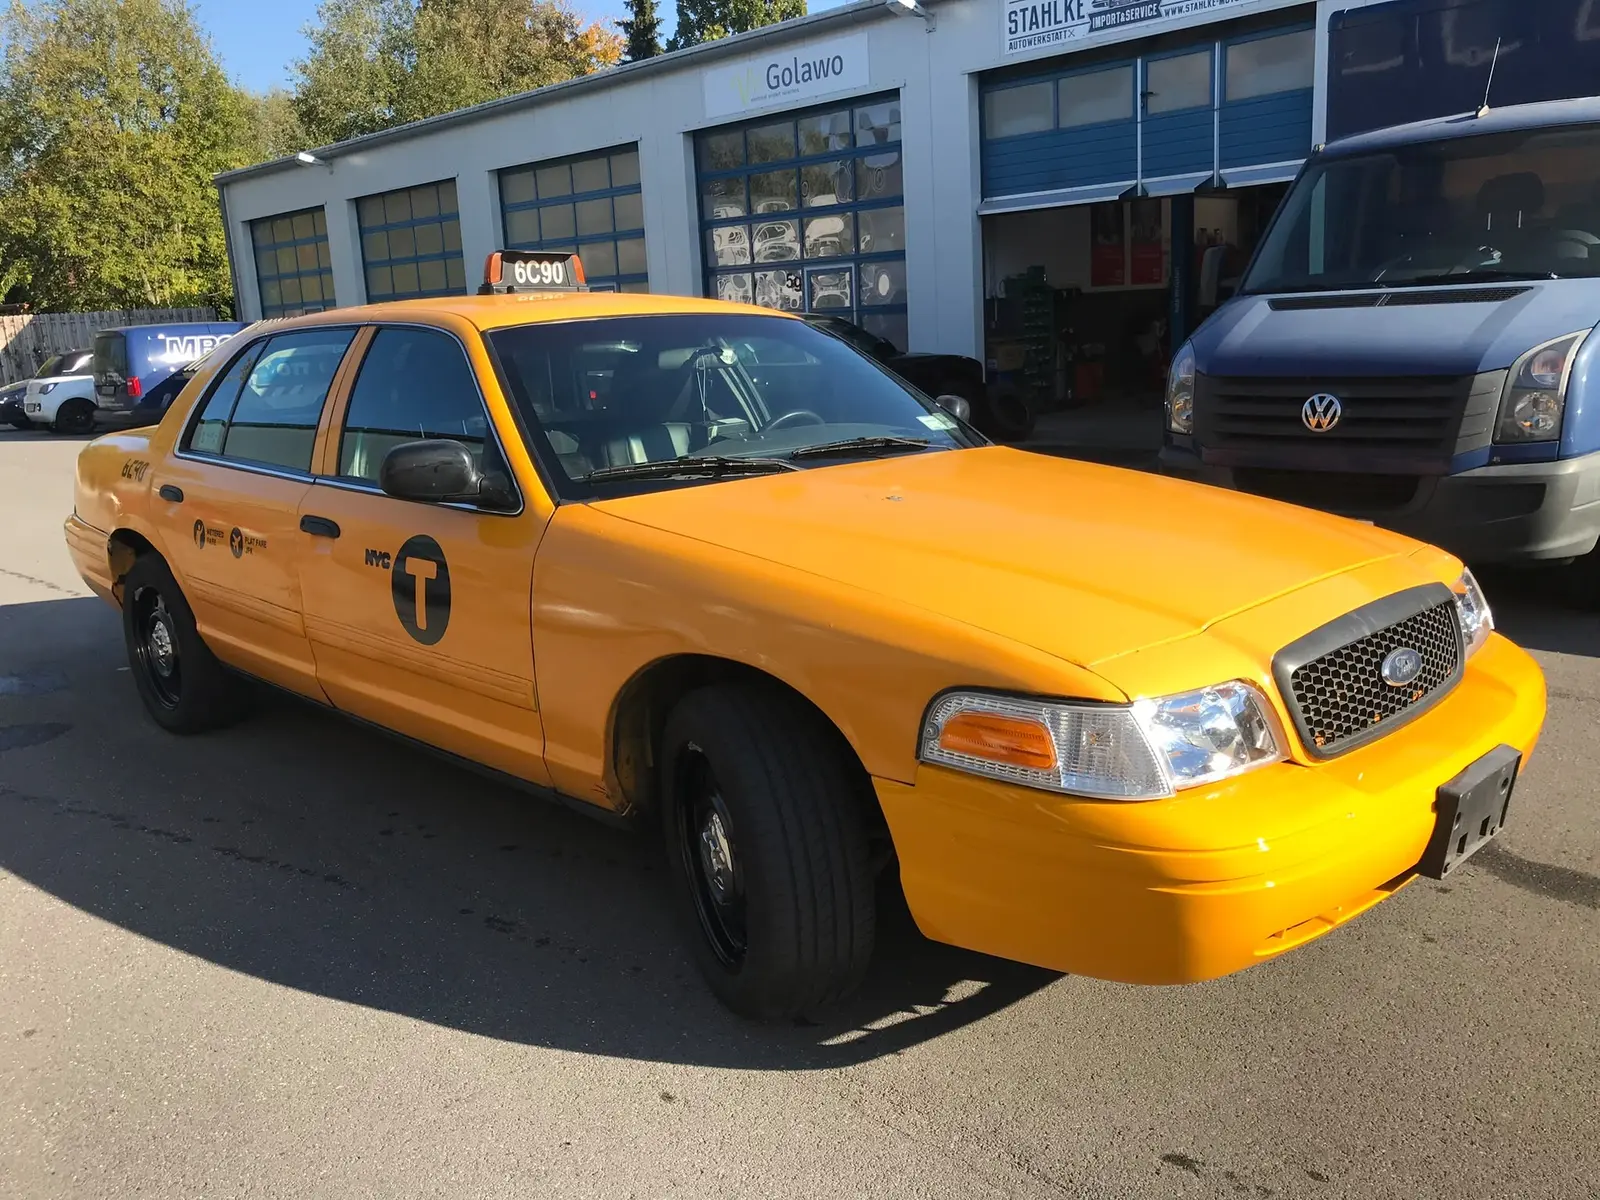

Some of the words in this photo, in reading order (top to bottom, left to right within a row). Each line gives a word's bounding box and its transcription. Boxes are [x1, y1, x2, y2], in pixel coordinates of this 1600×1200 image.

[1008, 0, 1085, 35] STAHLKE
[1092, 3, 1158, 29] IMPORT&SERVICE
[1008, 30, 1067, 51] AUTOWERKSTATT
[766, 55, 843, 90] Golawo
[514, 260, 564, 284] 6C90
[1303, 394, 1340, 431] VW
[121, 458, 150, 482] 6C90
[365, 548, 391, 569] NYC
[405, 556, 437, 631] T
